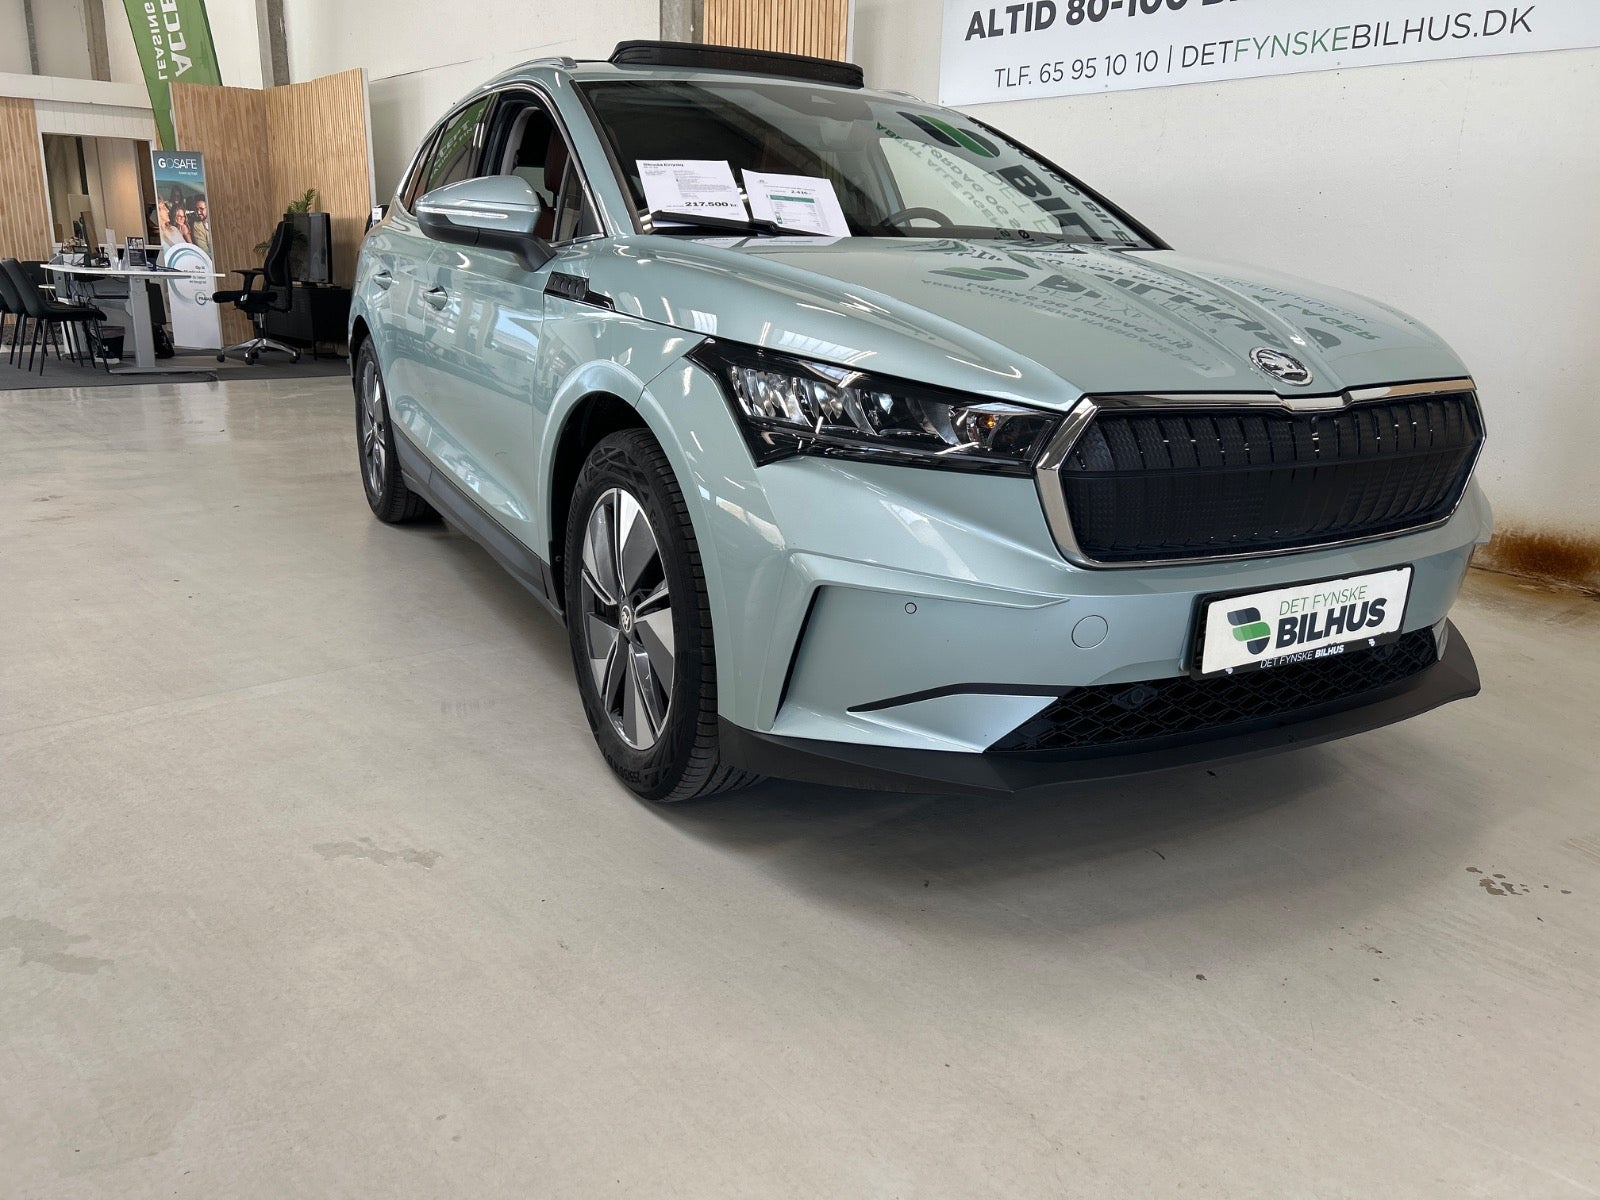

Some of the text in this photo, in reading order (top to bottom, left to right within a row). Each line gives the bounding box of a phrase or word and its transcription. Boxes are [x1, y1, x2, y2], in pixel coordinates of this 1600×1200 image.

[965, 0, 1057, 41] ALTID
[994, 65, 1032, 88] TLF.
[1039, 62, 1064, 83] 65
[1071, 58, 1097, 80] 95
[1104, 54, 1127, 77] 10
[1136, 50, 1159, 72] 10
[1181, 5, 1536, 68] DETFYNSKEBILHUS.DK
[158, 157, 198, 170] GOSAFE
[1279, 585, 1368, 616] DET FYNSKE
[1275, 598, 1388, 649] BILHUS
[1260, 645, 1344, 669] DET FYNSKE BILHUS
